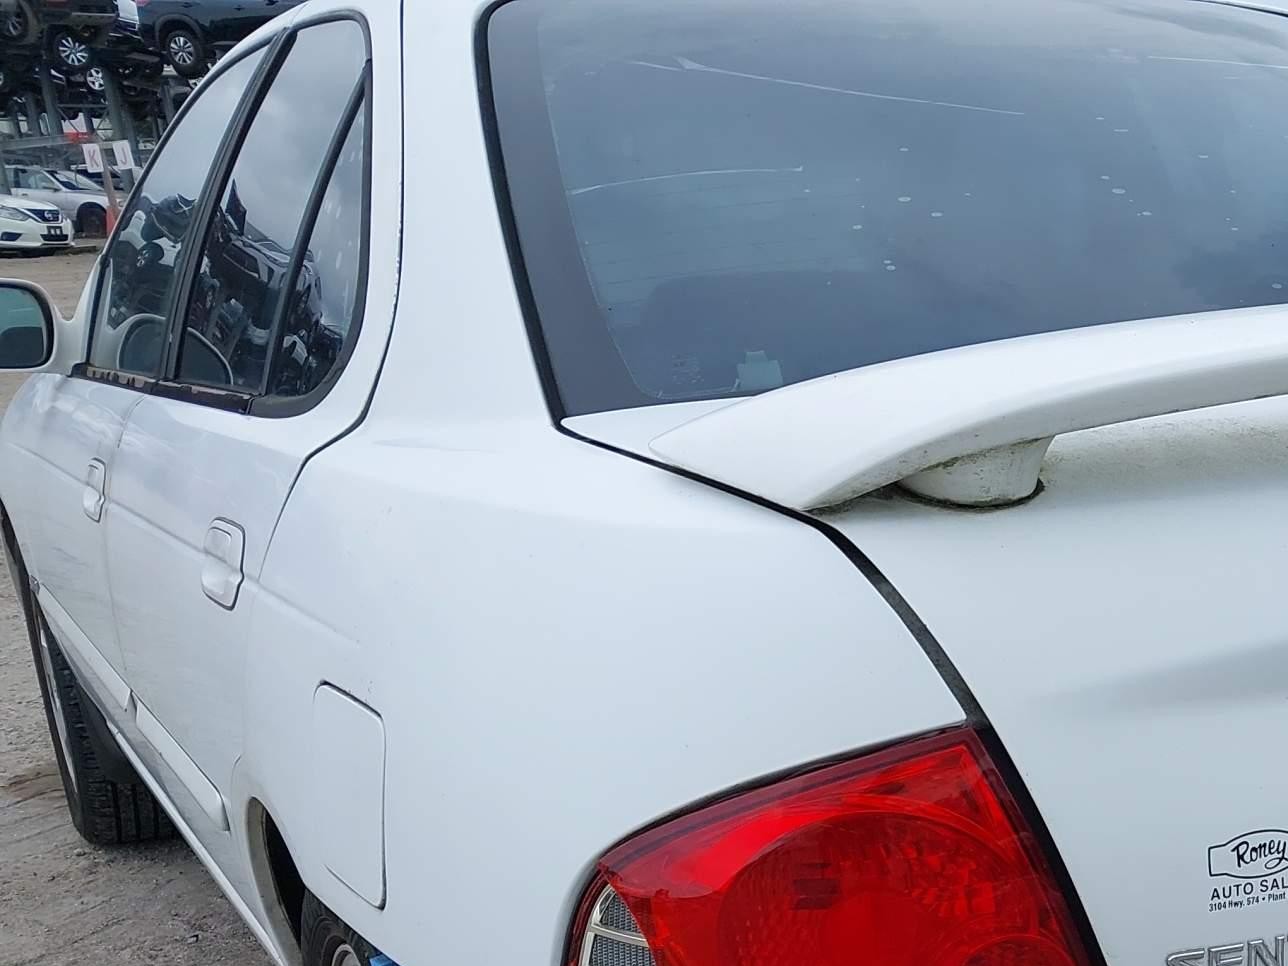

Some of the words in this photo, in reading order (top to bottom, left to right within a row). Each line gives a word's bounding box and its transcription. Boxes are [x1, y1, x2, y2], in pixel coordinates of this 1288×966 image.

[88, 149, 99, 168] K
[120, 147, 128, 165] J
[1231, 839, 1288, 870] Roney
[1210, 882, 1254, 901] AUTO
[1208, 900, 1227, 912] 3104
[1228, 899, 1245, 909] Hwy.
[1246, 895, 1260, 906] 574
[1267, 892, 1286, 903] Plant
